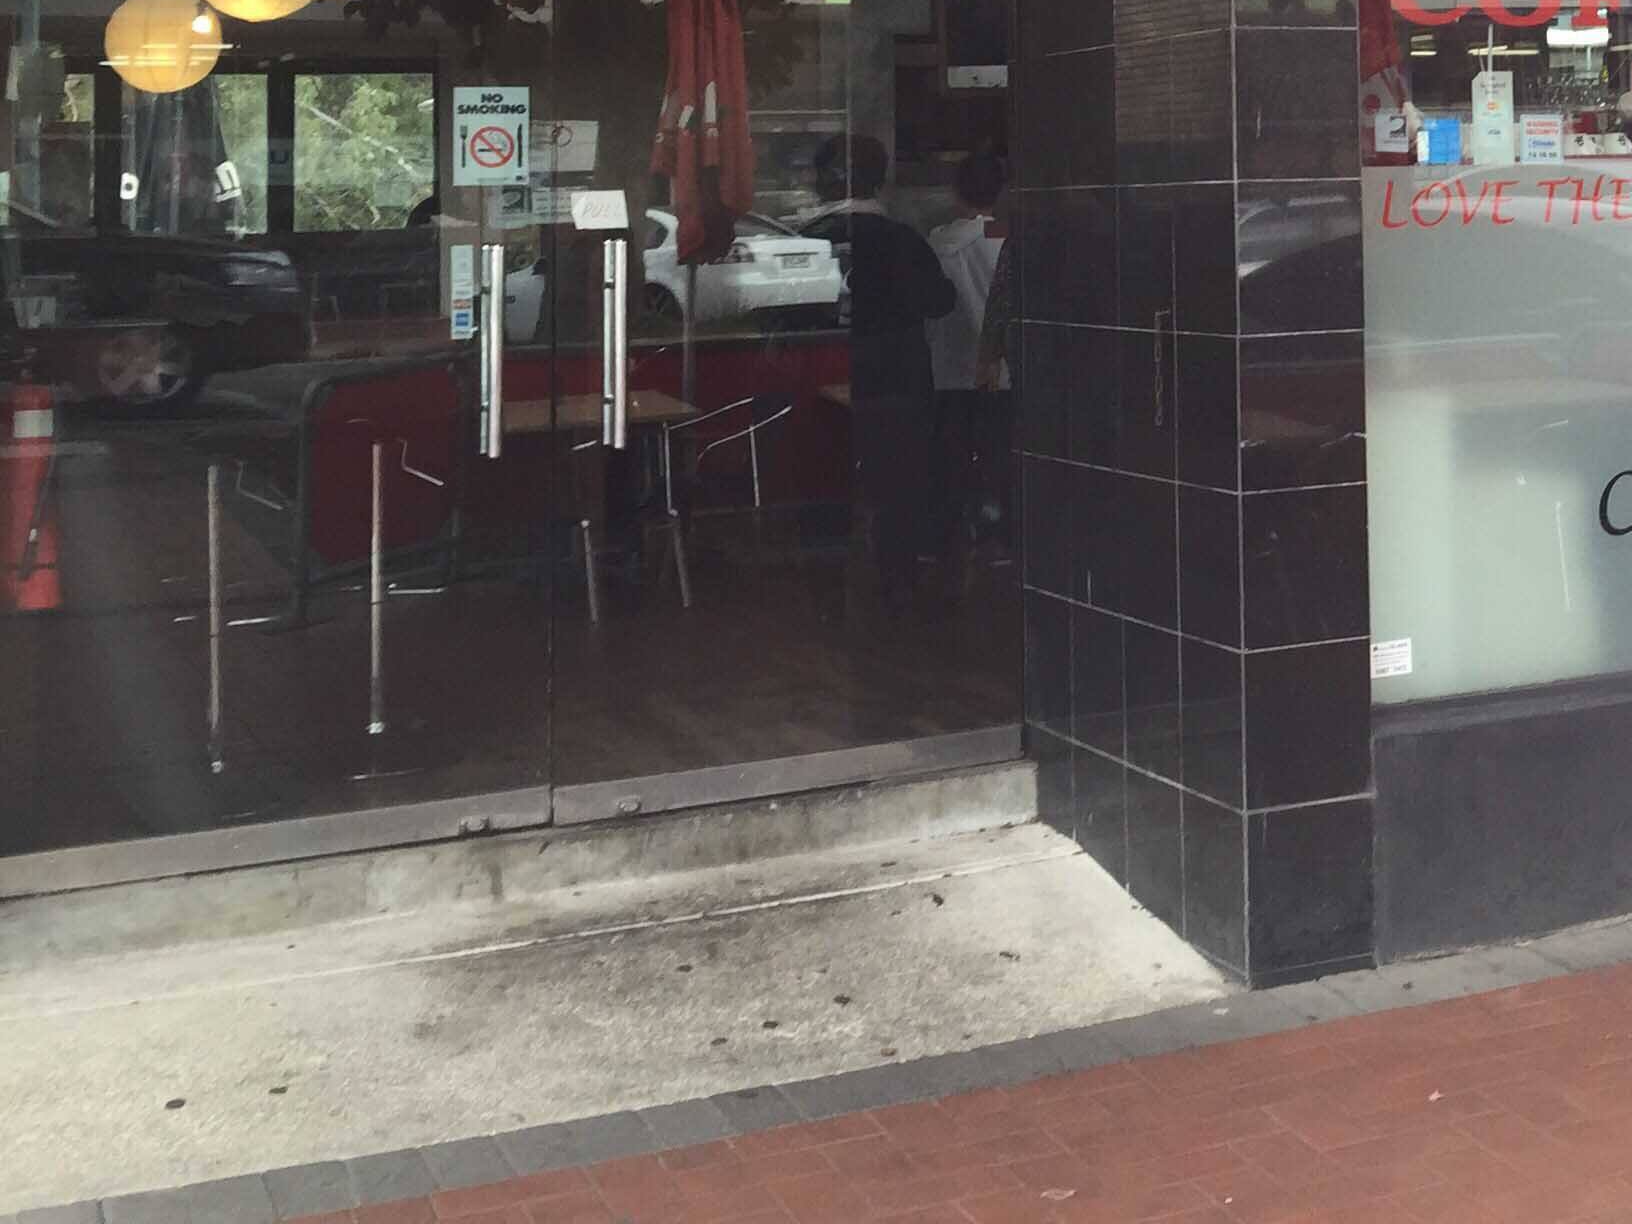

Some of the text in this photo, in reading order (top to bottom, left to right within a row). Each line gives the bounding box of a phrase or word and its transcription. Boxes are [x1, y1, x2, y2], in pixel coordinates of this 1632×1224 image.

[480, 92, 504, 103] NO
[457, 103, 528, 115] SMOKING
[1381, 179, 1518, 230] LOVE
